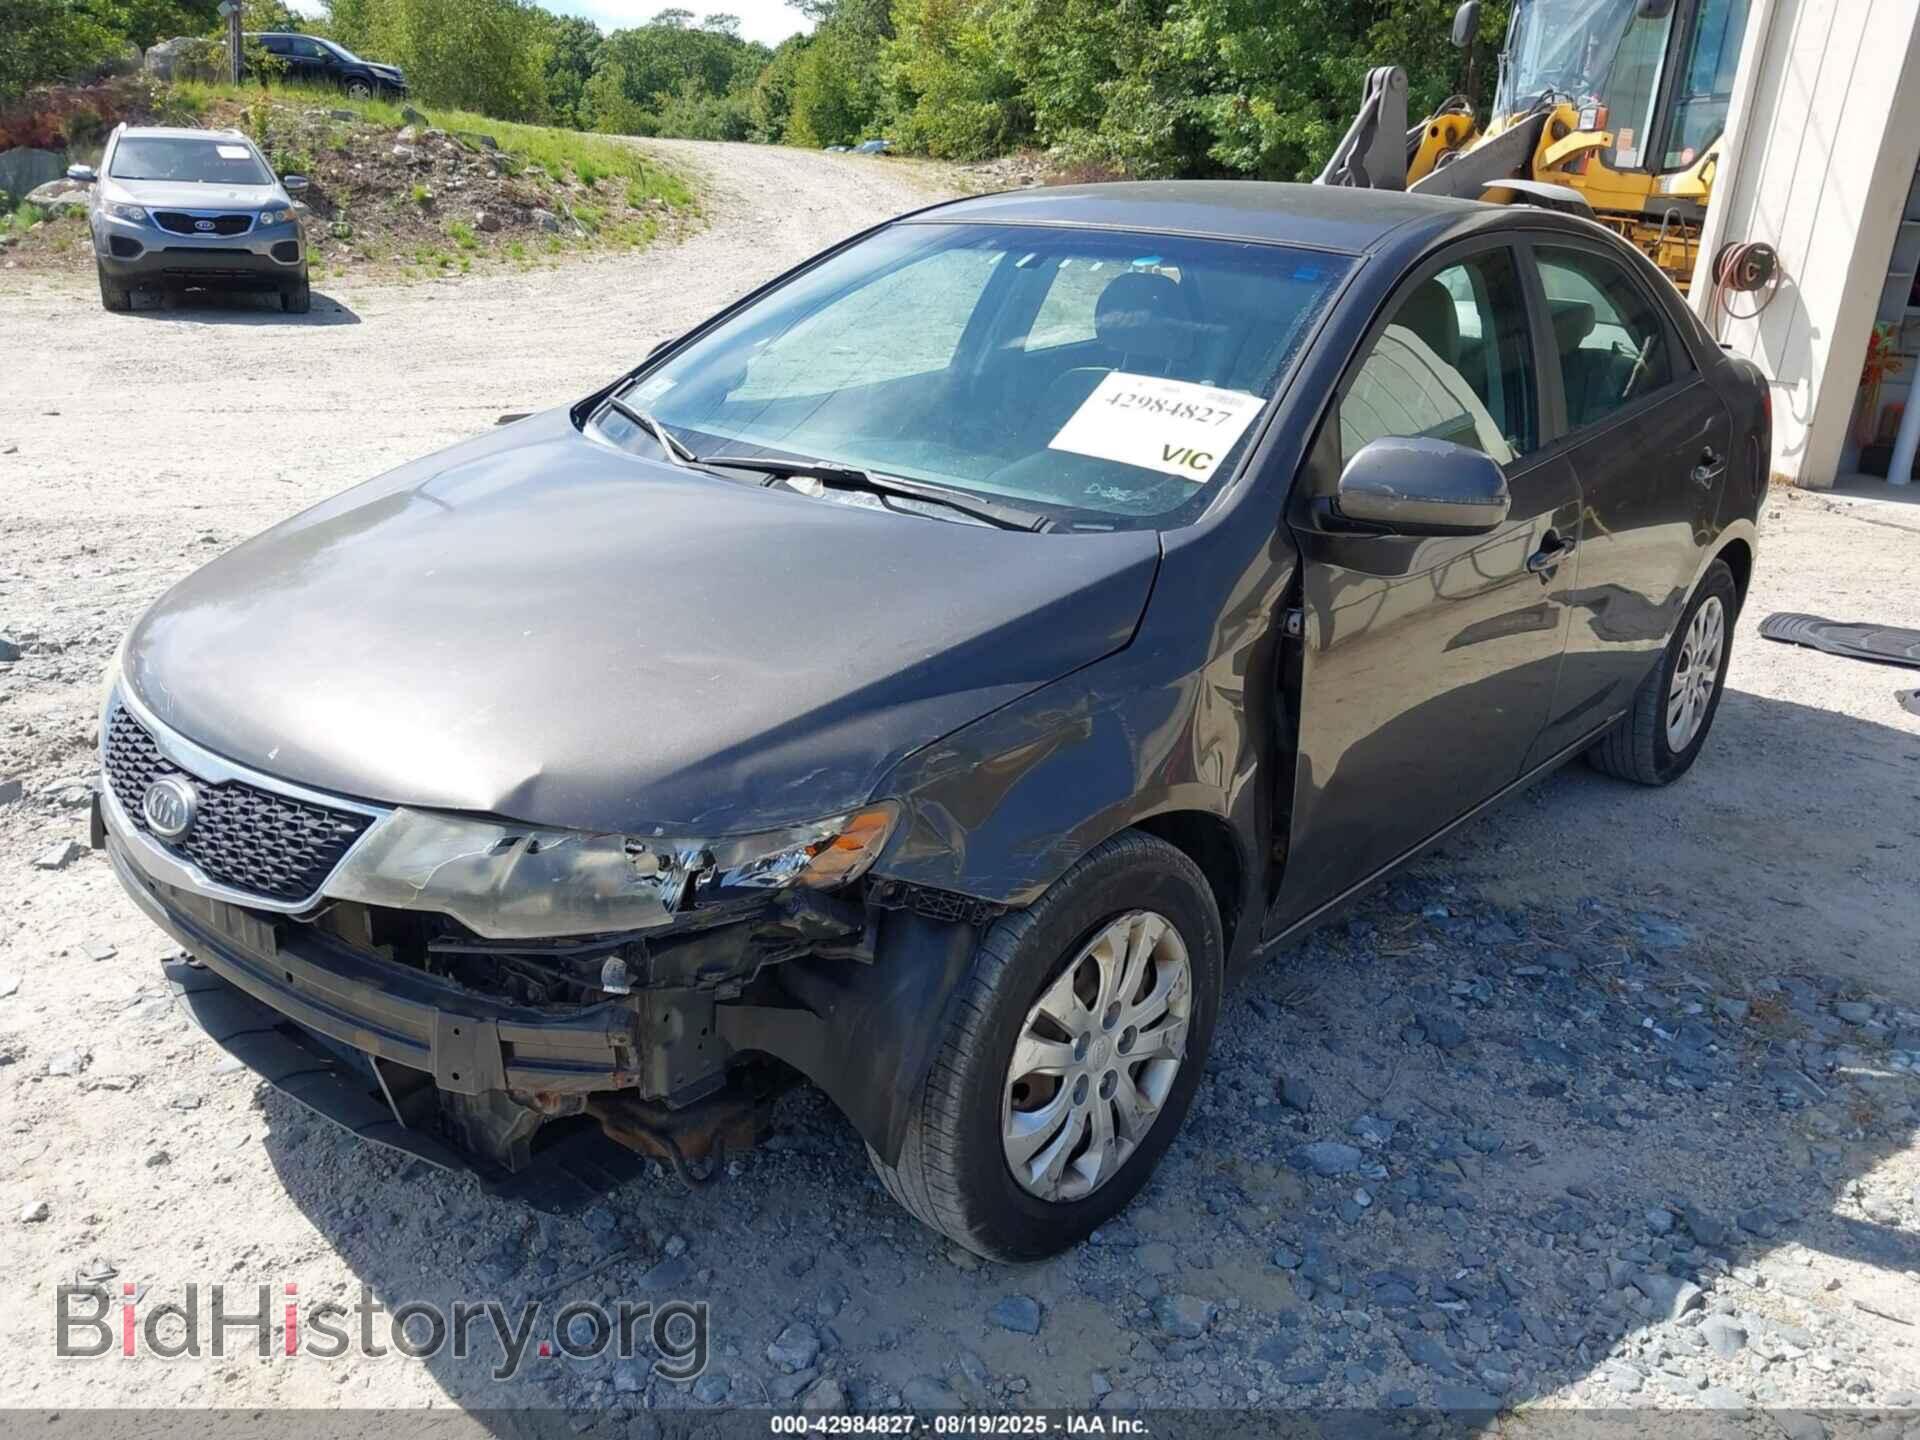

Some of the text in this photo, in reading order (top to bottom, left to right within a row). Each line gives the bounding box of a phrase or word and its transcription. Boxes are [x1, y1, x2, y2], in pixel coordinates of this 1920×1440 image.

[1105, 391, 1233, 426] 42984827
[1161, 443, 1214, 471] VIC
[149, 784, 180, 829] KIA
